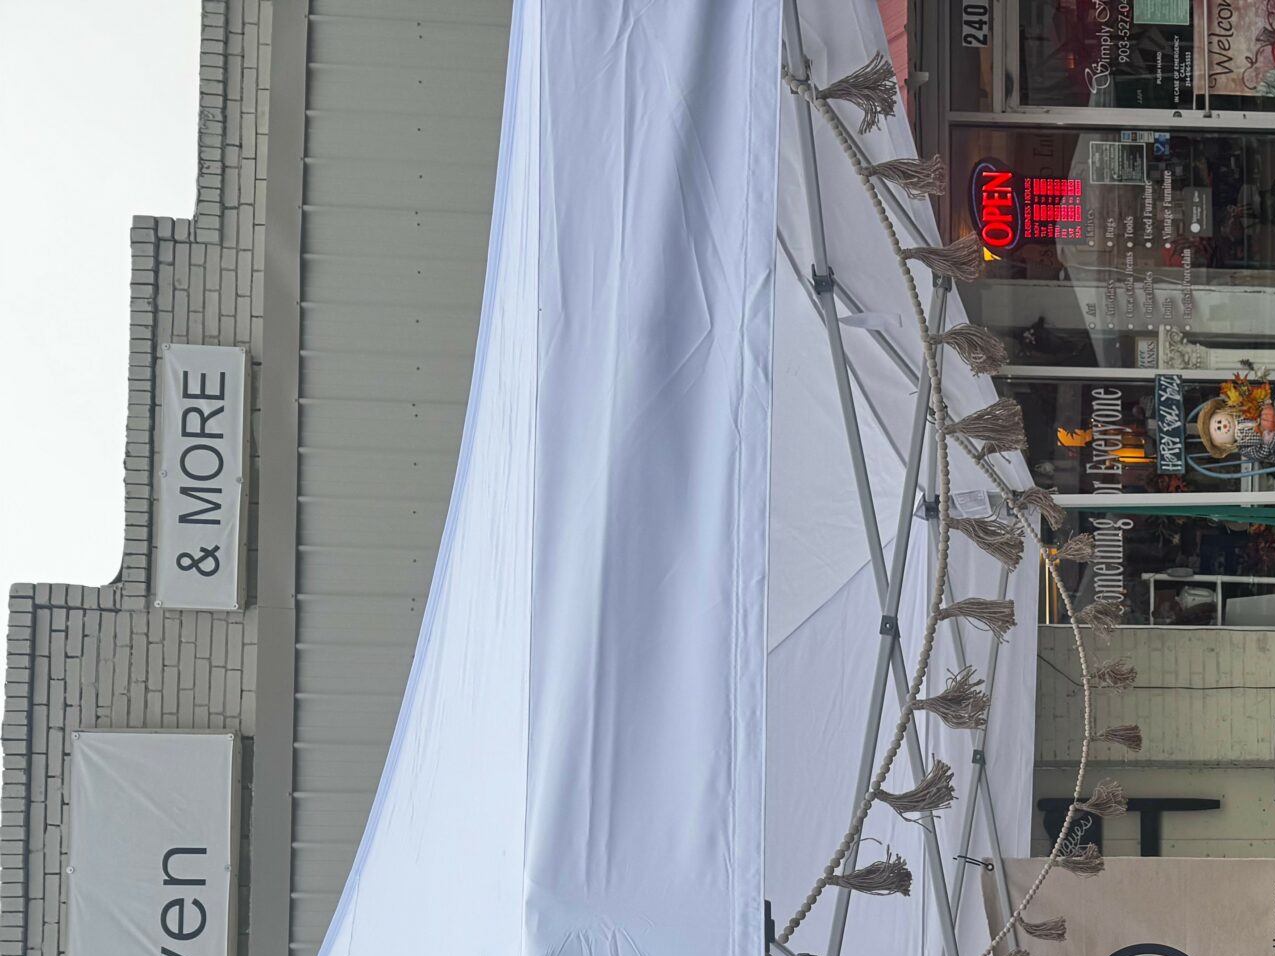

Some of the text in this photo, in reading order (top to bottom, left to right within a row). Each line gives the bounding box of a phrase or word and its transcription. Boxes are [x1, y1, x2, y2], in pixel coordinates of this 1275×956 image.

[963, 4, 988, 46] 240
[1084, 25, 1114, 94] Simply
[981, 171, 1014, 247] OPEN
[1106, 217, 1116, 238] Rugs
[1126, 215, 1134, 238] Tools
[1144, 180, 1152, 239] Used Furniture
[1162, 170, 1173, 240] Vintage Furniture
[1125, 251, 1134, 274] Items
[1183, 248, 1192, 286] Porcelain
[1086, 388, 1132, 474] Everyone
[175, 370, 226, 578] & MORE
[1088, 516, 1134, 614] omething
